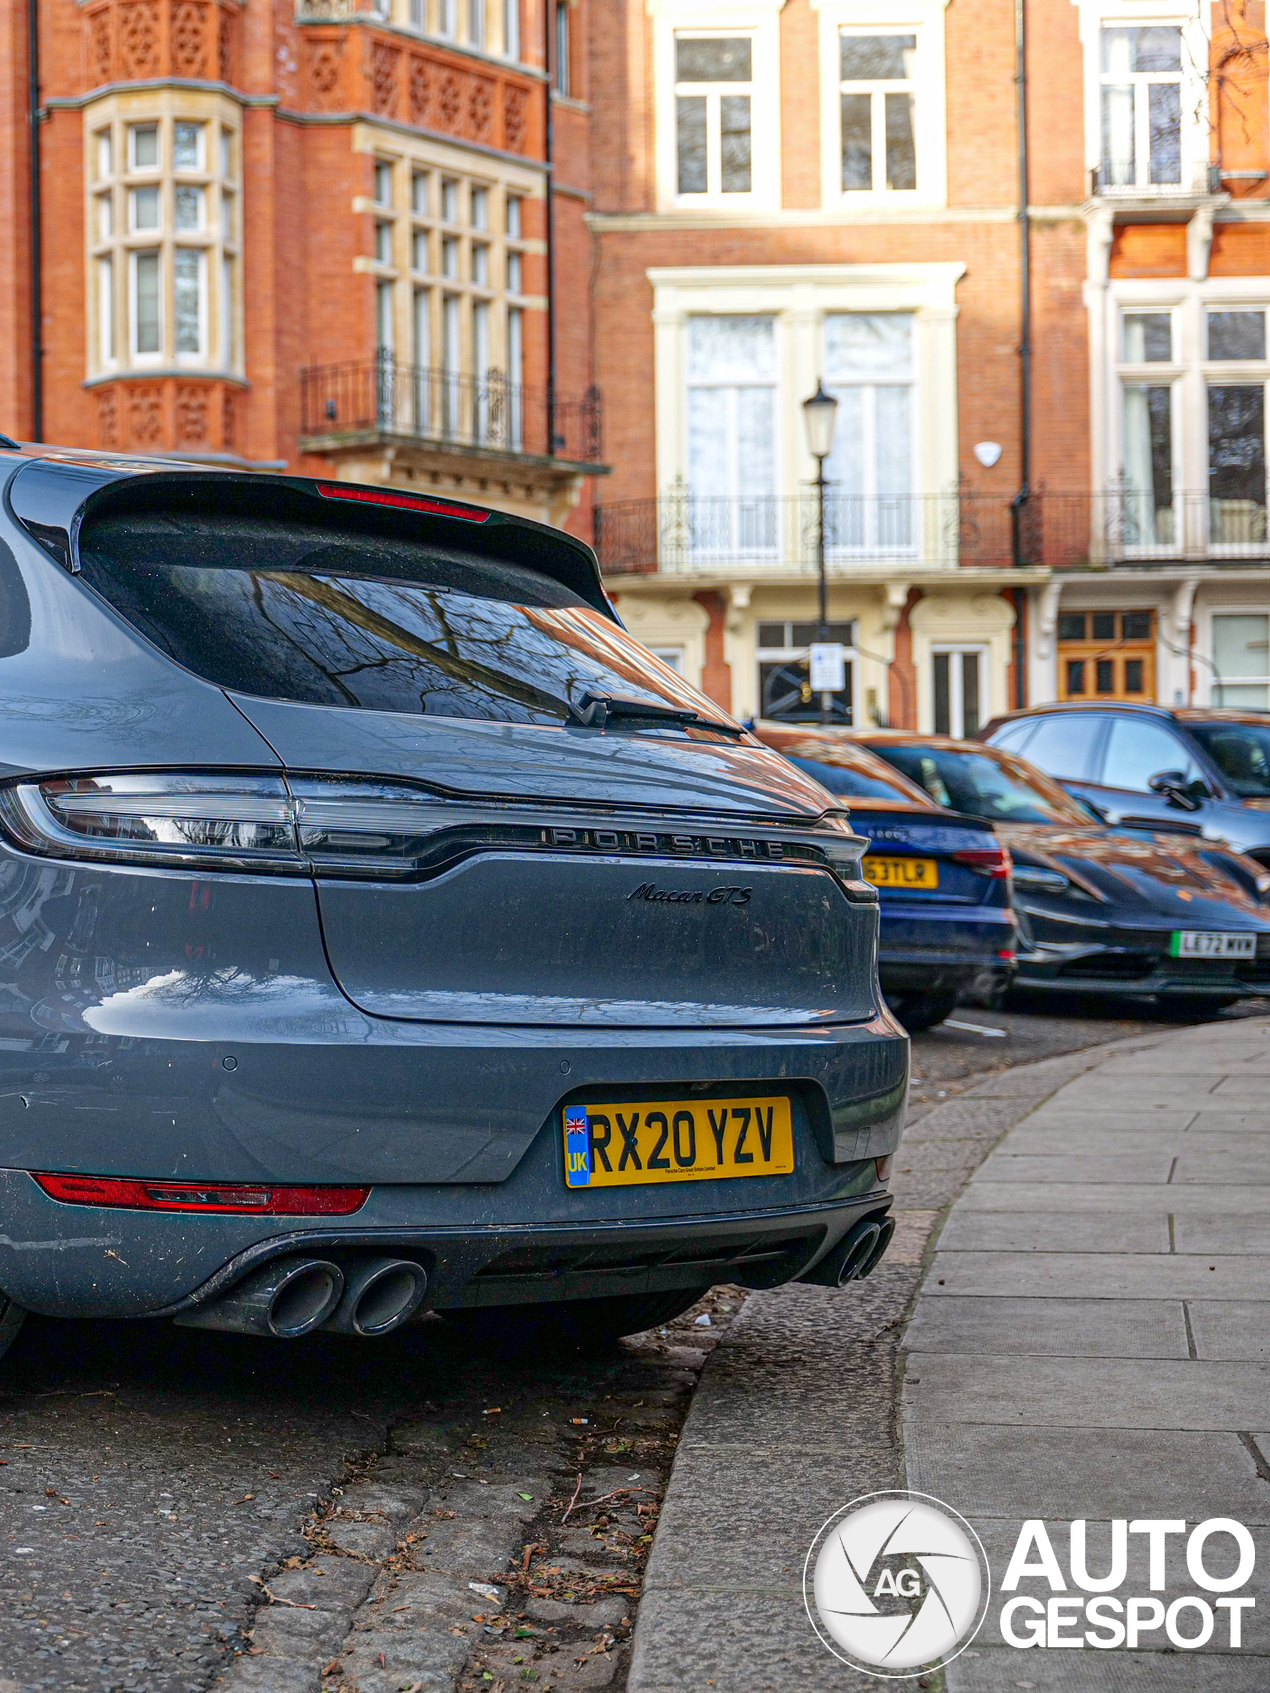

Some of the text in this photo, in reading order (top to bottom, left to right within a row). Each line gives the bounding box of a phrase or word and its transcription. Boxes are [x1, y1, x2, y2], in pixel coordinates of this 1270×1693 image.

[551, 828, 785, 858] PORSCHE
[627, 881, 753, 904] Macan GTS
[589, 1105, 774, 1173] RX20 YZV
[567, 1151, 588, 1173] UK
